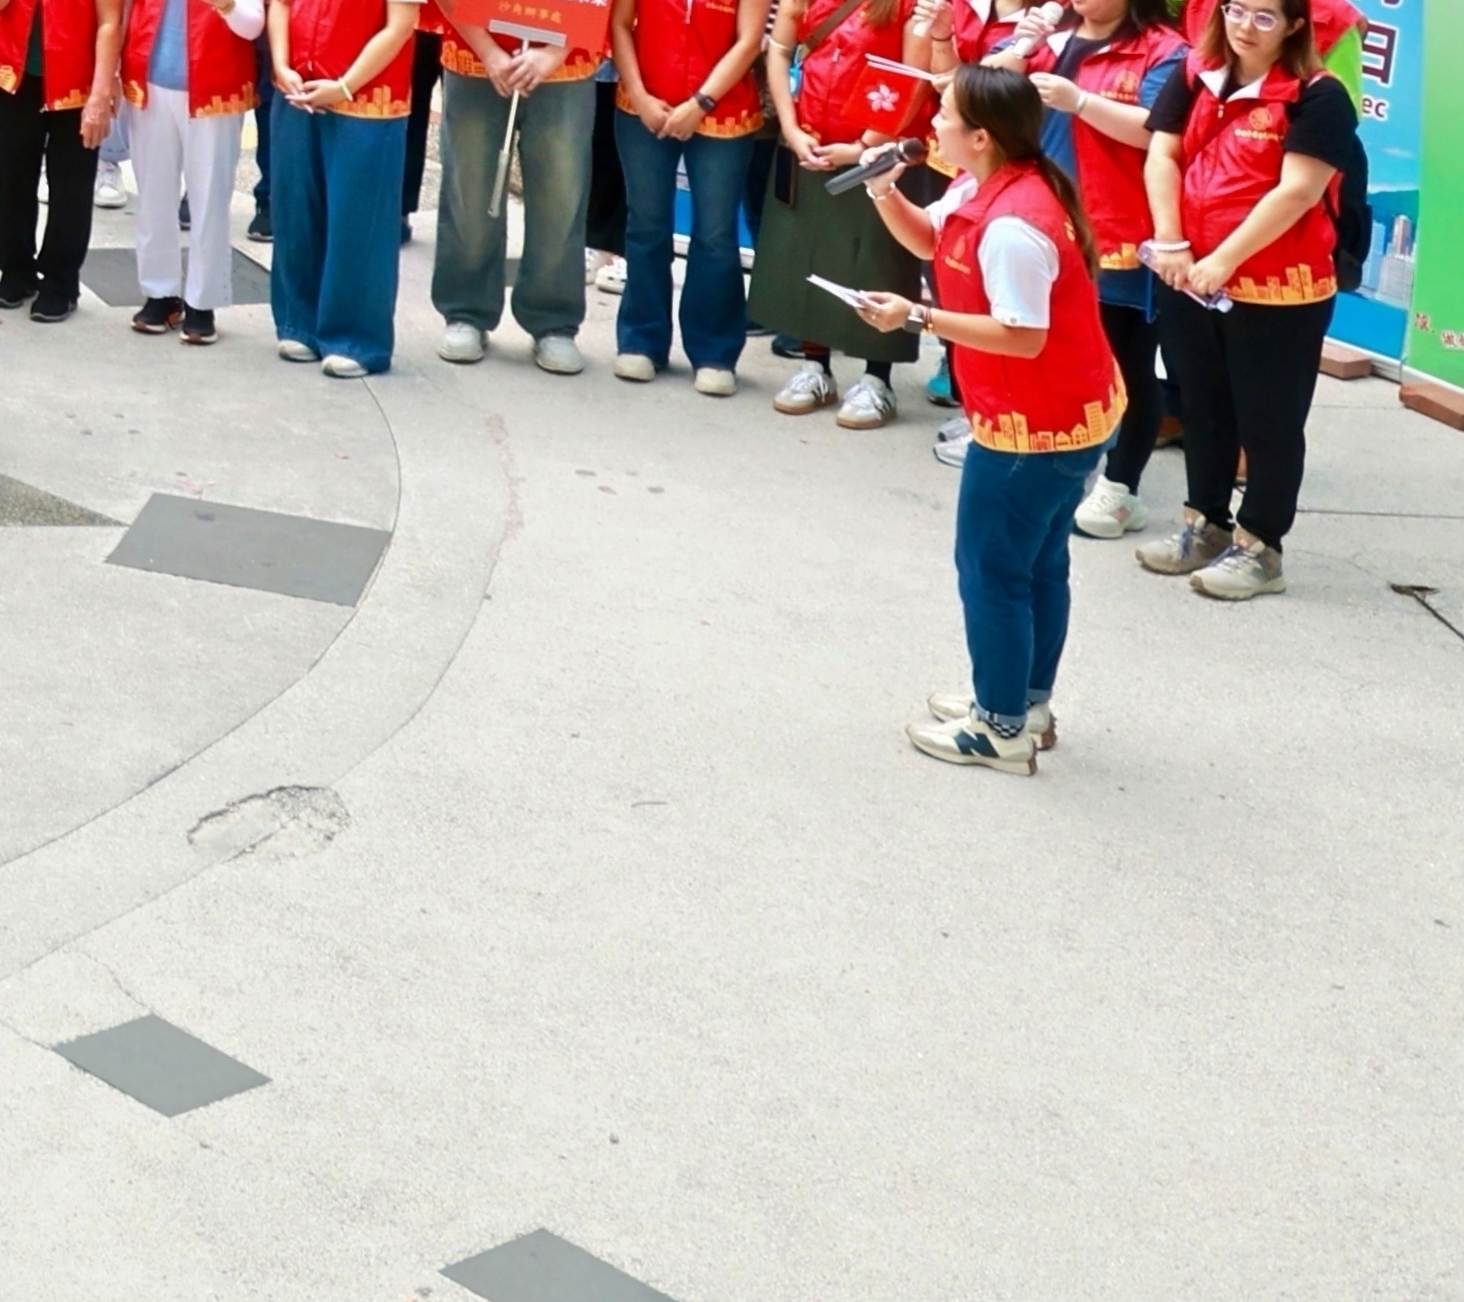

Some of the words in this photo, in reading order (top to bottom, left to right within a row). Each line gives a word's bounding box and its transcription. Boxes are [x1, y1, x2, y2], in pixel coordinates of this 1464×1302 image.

[499, 2, 560, 23] 沙角辦事處
[1362, 97, 1386, 118] ec
